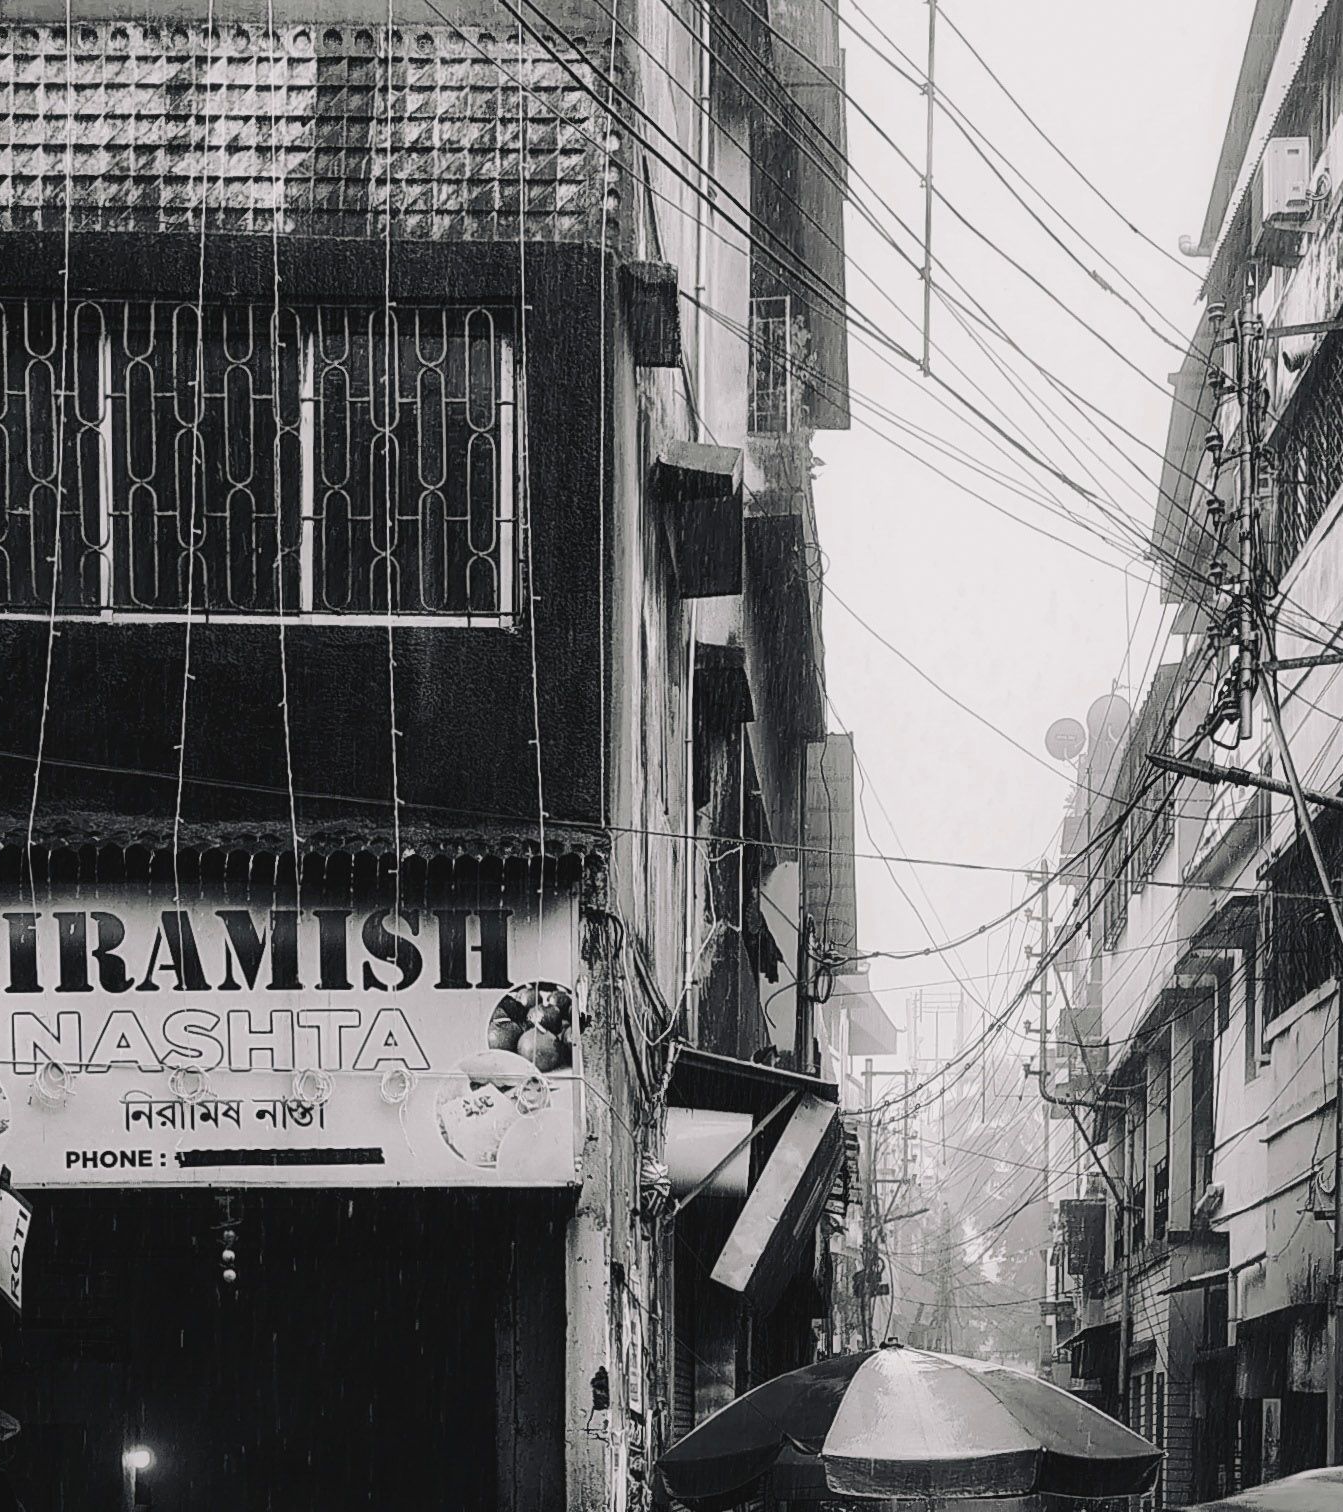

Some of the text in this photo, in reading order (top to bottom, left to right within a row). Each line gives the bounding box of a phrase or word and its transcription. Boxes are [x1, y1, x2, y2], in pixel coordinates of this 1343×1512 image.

[11, 1008, 431, 1075] NASHTA
[120, 1090, 244, 1132] নিরামিষ
[65, 1150, 153, 1169] PHONE
[10, 1208, 29, 1303] ROTI
